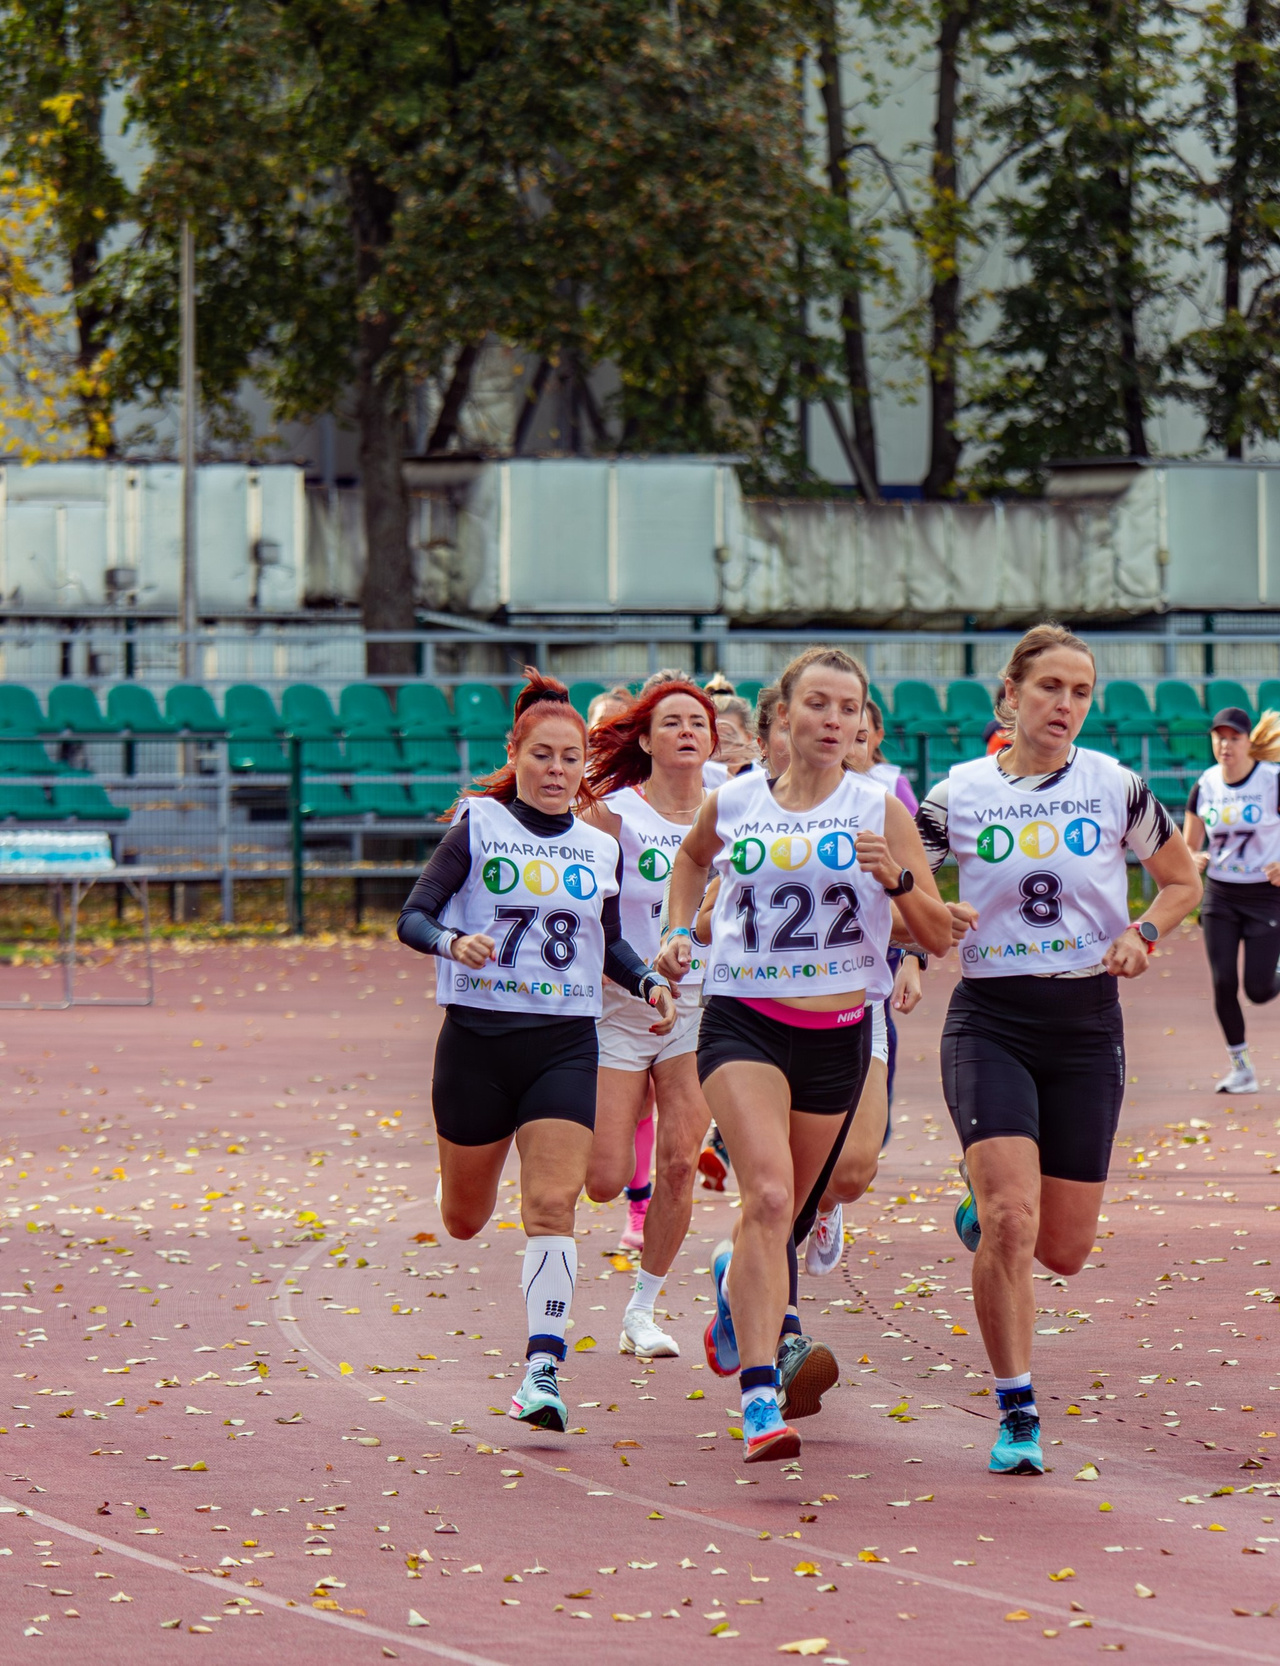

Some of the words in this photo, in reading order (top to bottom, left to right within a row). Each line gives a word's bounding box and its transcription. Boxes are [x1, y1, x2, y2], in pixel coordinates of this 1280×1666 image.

[974, 799, 1101, 823] VMARAFONE
[733, 815, 860, 838] VMARAFONE
[481, 840, 596, 863] VMARAFONE
[1213, 829, 1256, 860] 77
[1019, 870, 1062, 928] 8
[735, 882, 865, 953] 122
[494, 905, 581, 972] 78
[978, 931, 1109, 959] VMARAFONE.CLU
[730, 955, 875, 980] VMARAFONE.CLUB
[469, 977, 595, 998] VMARAFONE.CLUB
[837, 1007, 863, 1024] NIKE
[545, 1310, 563, 1318] cep
